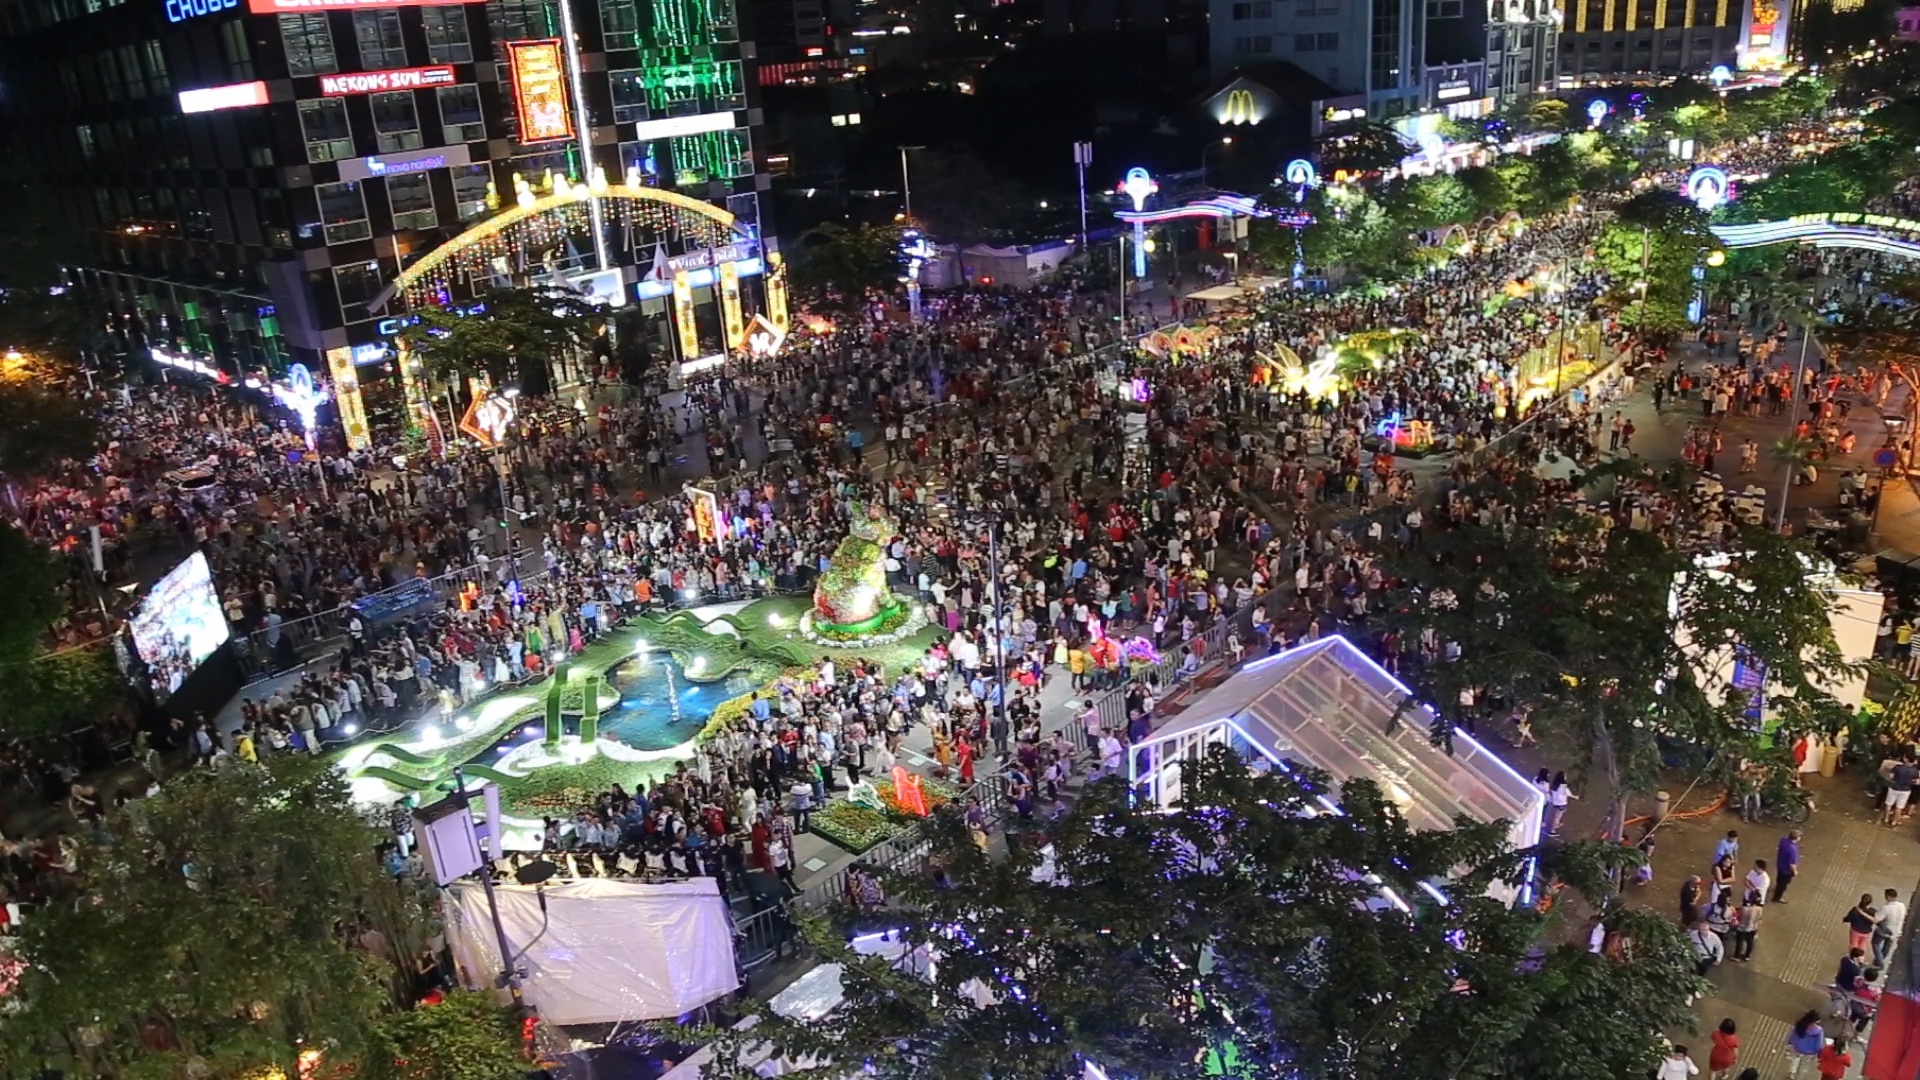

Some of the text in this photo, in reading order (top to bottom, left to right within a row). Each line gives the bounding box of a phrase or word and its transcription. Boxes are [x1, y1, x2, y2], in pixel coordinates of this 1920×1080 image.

[322, 71, 421, 93] MEKONG SUN
[387, 155, 445, 174] novo nordisk
[675, 247, 738, 268] VinaCpital
